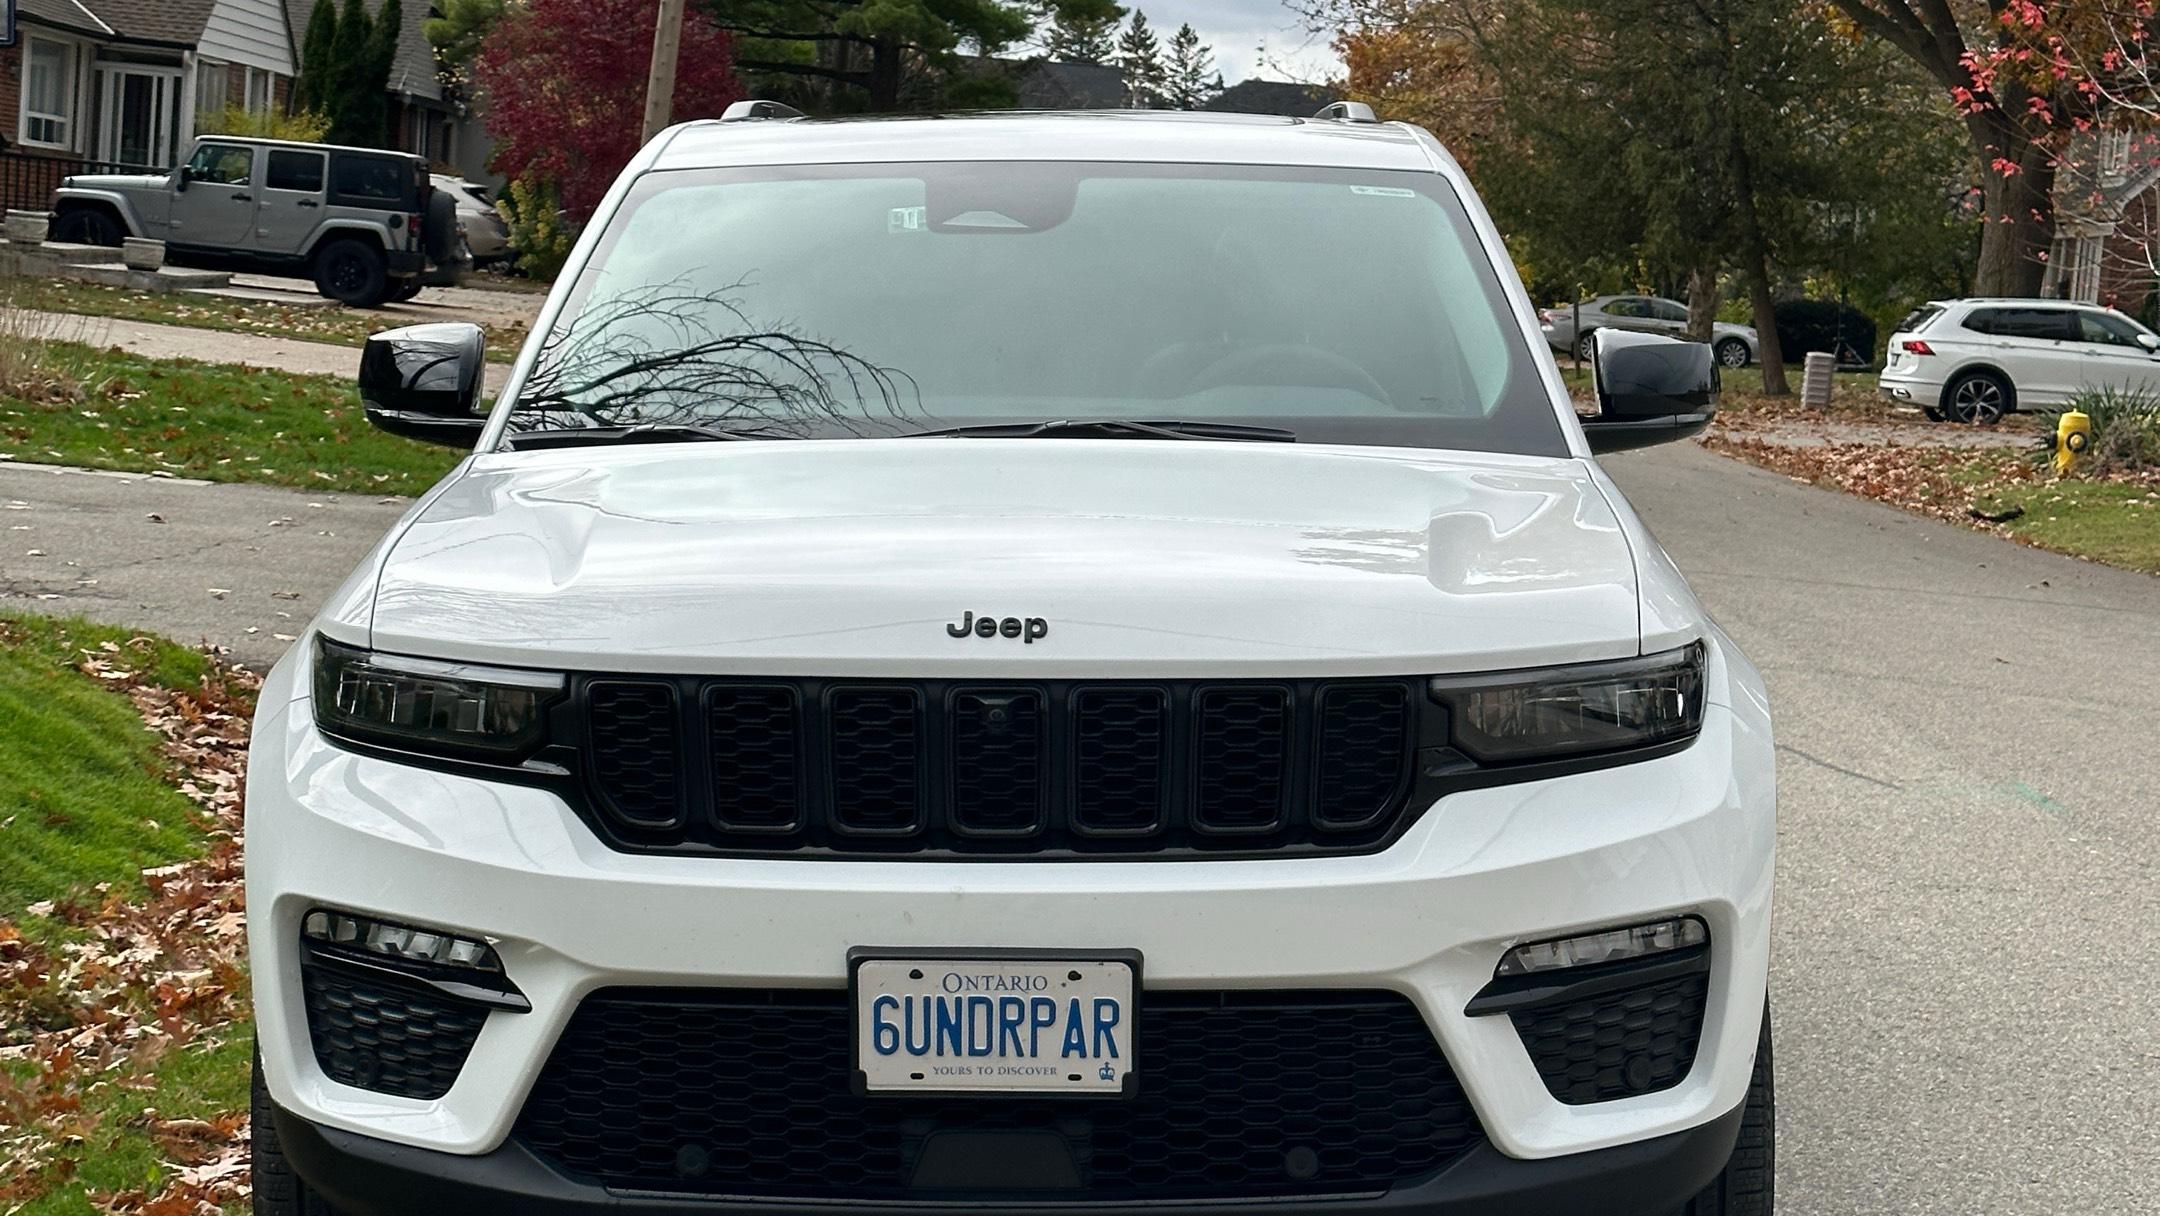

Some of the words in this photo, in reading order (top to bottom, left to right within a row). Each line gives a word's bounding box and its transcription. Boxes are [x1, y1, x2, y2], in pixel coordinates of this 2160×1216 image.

[946, 610, 1048, 644] Jeep
[942, 972, 1048, 994] ONTARIO
[873, 995, 1120, 1059] 6UNDRPAR
[933, 1066, 973, 1076] YOURS
[976, 1066, 994, 1076] TO
[998, 1066, 1057, 1076] DISCOVER
